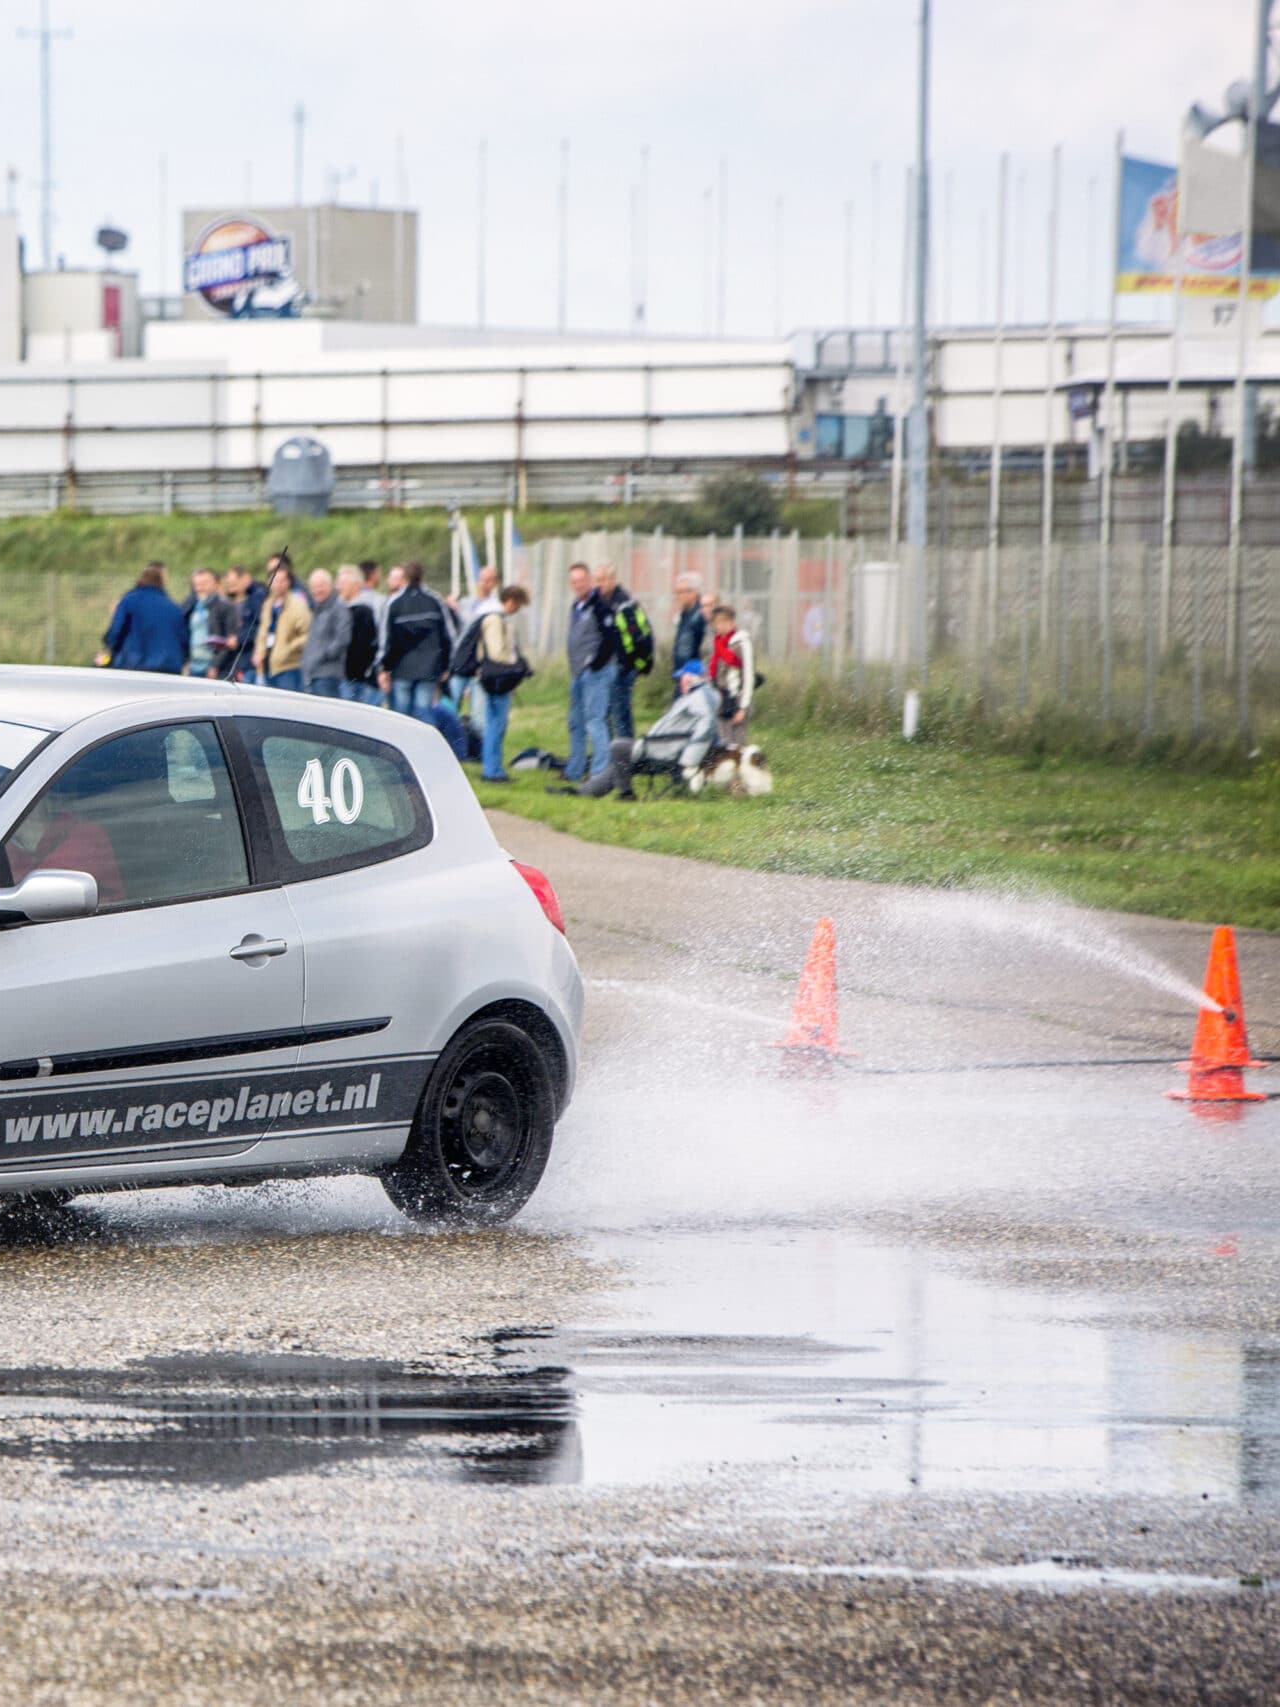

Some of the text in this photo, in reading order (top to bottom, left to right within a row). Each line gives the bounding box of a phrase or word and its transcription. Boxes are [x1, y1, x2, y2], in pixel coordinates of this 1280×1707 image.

[1213, 303, 1239, 328] 17
[297, 758, 364, 825] 40
[5, 1073, 382, 1144] www.raceplanet.nl
